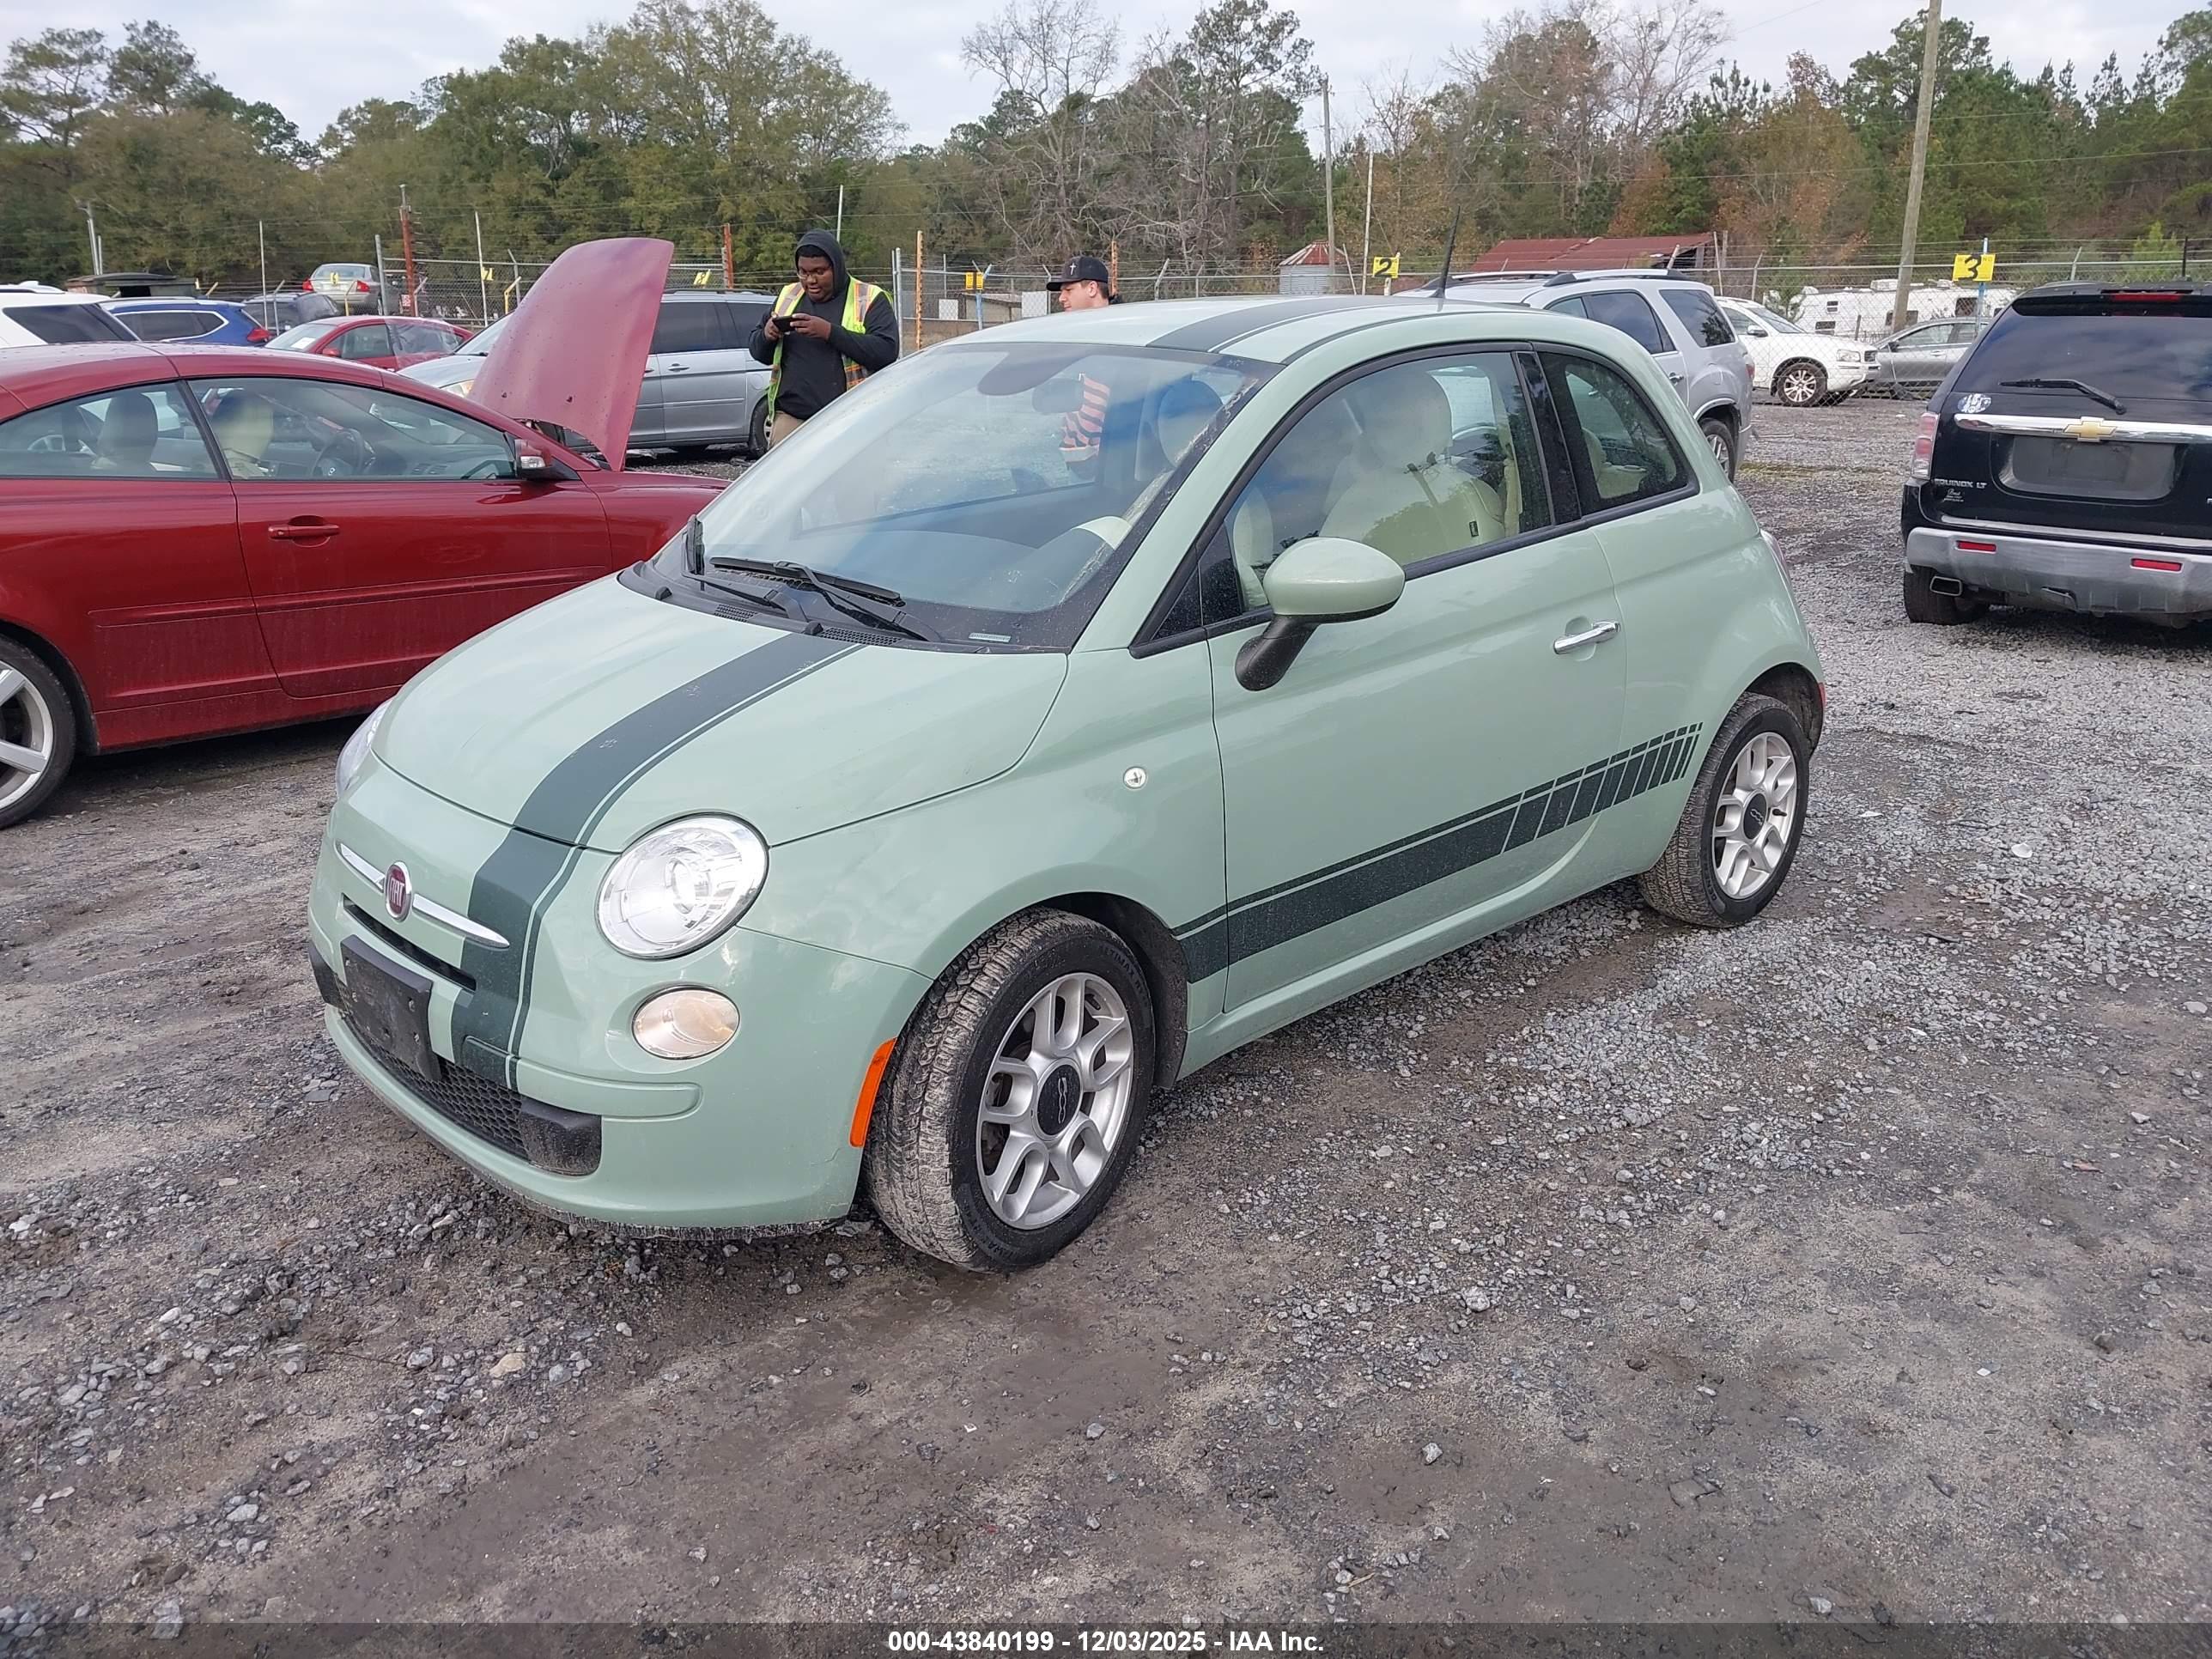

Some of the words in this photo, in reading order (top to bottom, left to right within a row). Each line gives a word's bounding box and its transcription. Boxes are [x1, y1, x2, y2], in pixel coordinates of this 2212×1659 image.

[1374, 258, 1393, 278] 2
[1958, 252, 1982, 281] 3
[389, 877, 405, 907] FIAT
